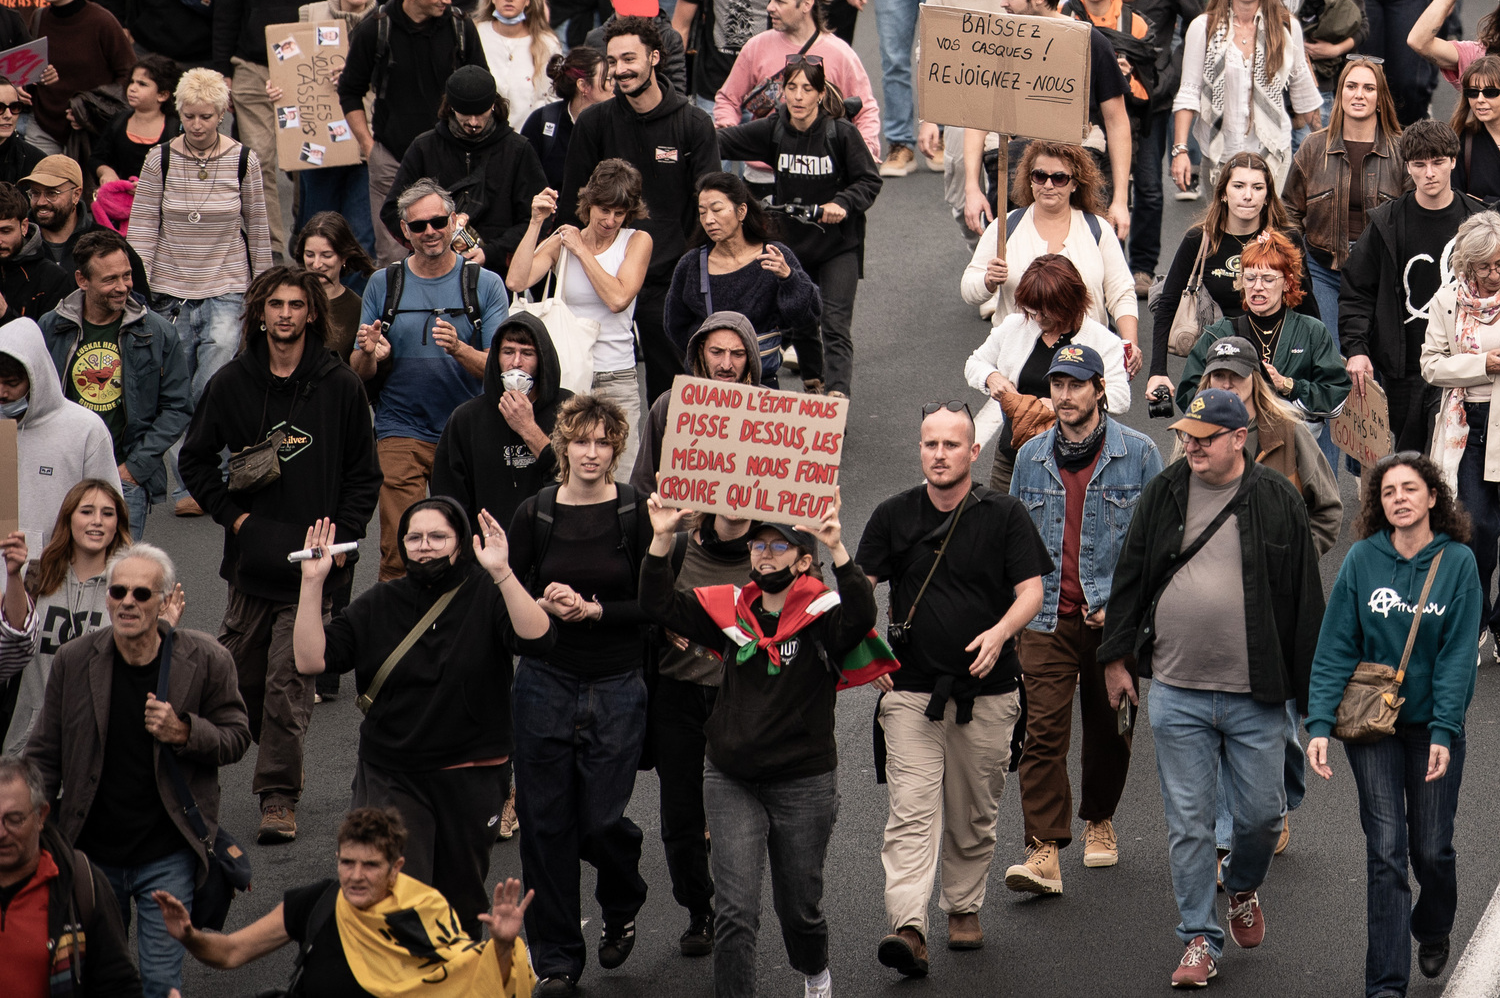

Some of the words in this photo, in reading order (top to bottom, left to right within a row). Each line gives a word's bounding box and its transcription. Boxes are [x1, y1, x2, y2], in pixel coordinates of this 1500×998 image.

[936, 37, 960, 50] VOS
[972, 40, 1032, 60] CASQUES
[297, 63, 317, 137] CASSEURS
[777, 153, 833, 176] PUMA
[76, 341, 102, 357] EUSKAL
[681, 383, 743, 409] QUAND
[747, 390, 797, 413] L'ÉTAT
[798, 399, 839, 419] NOUS
[676, 412, 730, 439] PISSE
[739, 419, 809, 455] DESSUS,
[811, 430, 842, 454] LES
[671, 438, 736, 473] MÉDIAS
[746, 455, 790, 479] NOUS
[795, 460, 839, 485] FONT
[660, 475, 720, 505] CROIRE
[726, 479, 774, 511] QU'IL
[777, 490, 834, 519] PLEUT
